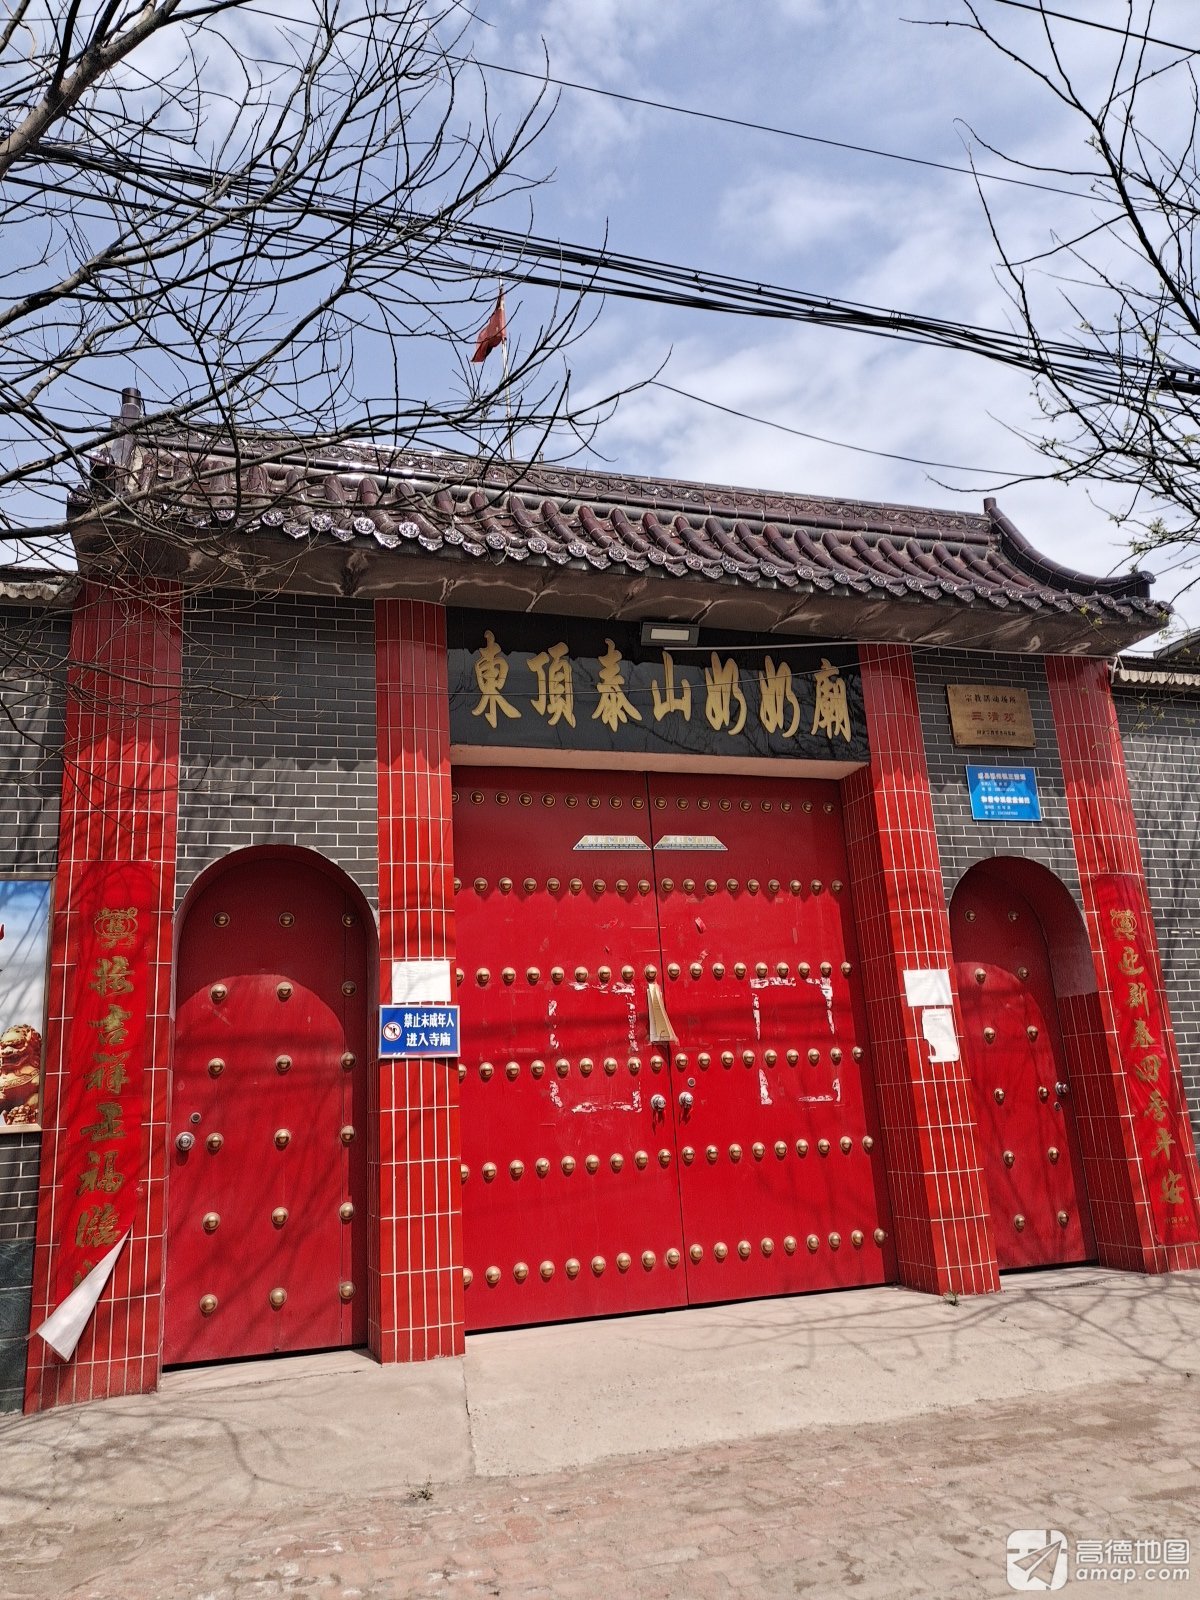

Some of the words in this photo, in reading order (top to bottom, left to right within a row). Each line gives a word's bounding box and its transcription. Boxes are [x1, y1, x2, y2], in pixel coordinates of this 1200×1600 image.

[404, 1012, 455, 1028] 禁止未成年人
[406, 1032, 451, 1047] 进入寺庙
[1118, 945, 1185, 1205] 迎新春四季平安
